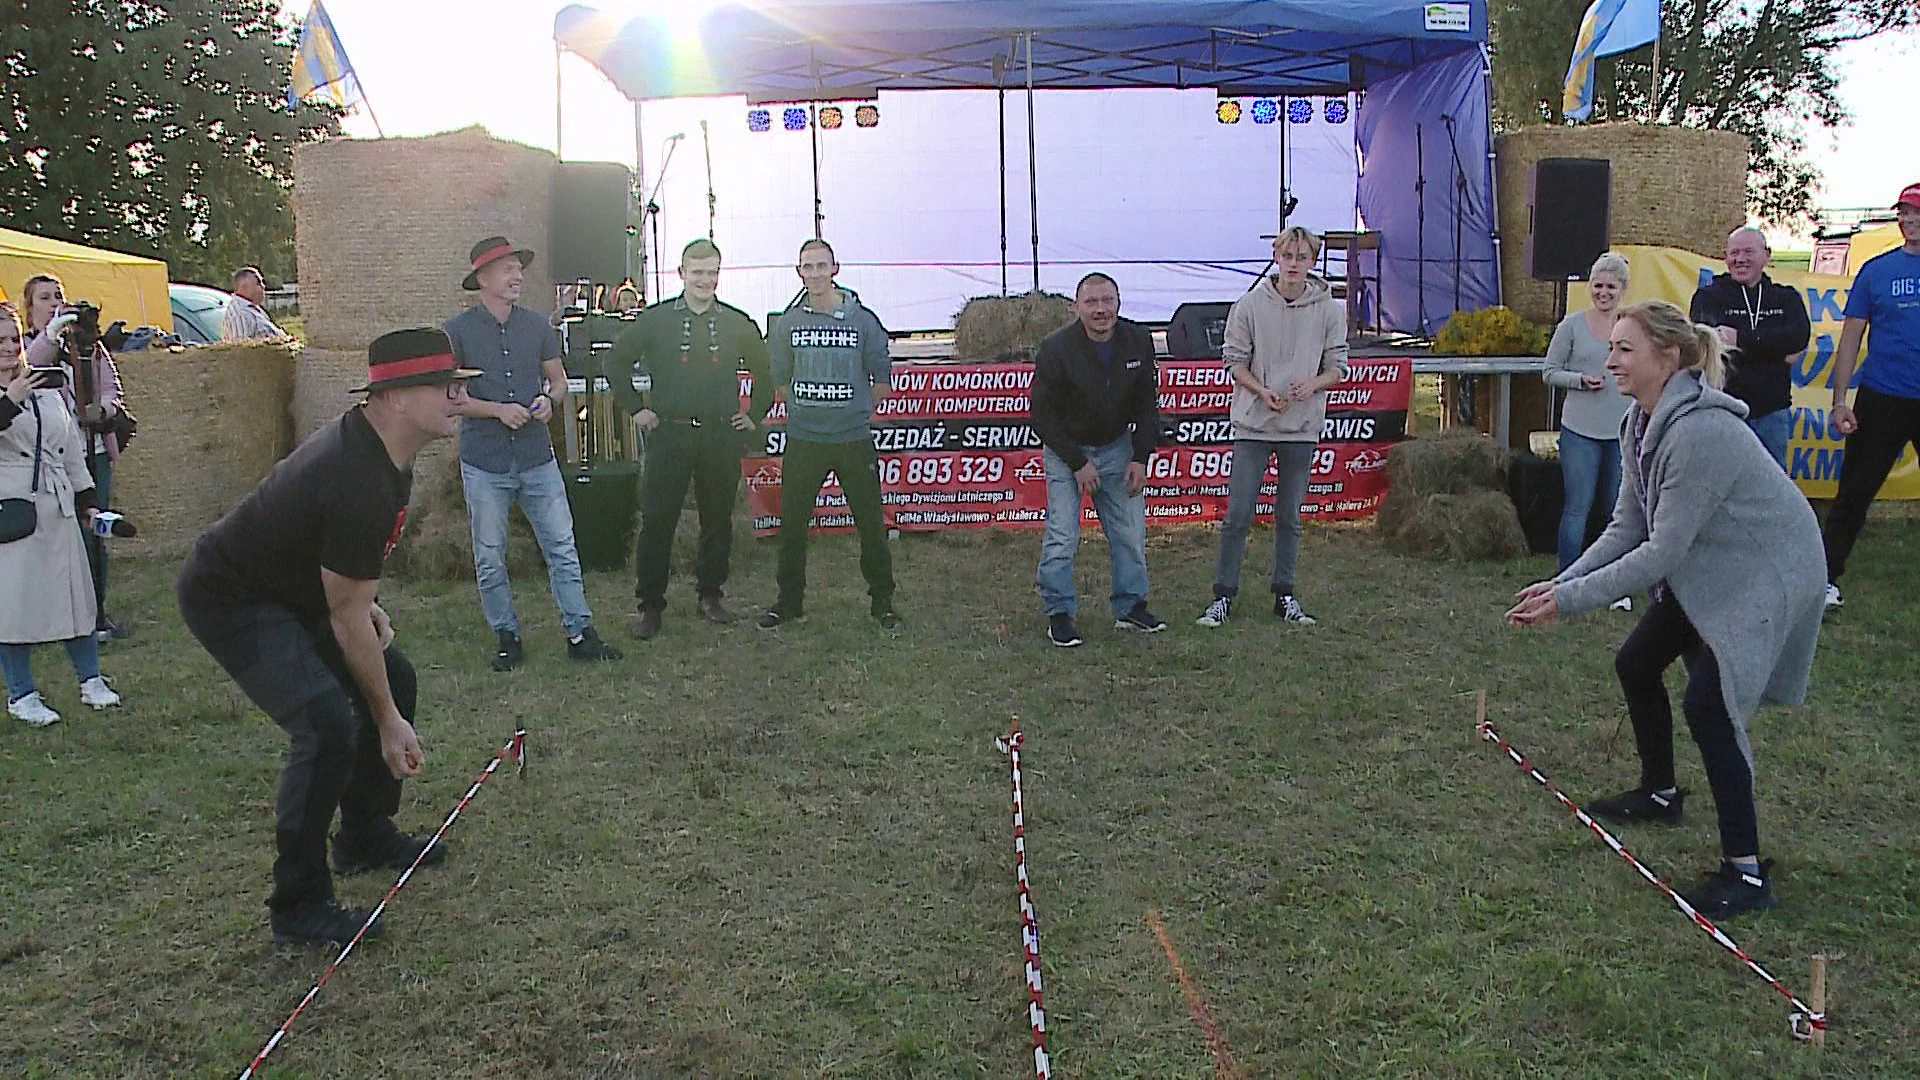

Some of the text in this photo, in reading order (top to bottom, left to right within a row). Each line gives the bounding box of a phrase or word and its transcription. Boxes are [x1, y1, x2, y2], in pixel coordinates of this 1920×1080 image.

[1892, 278, 1914, 296] BIG
[791, 330, 858, 347] GENUINE
[906, 457, 954, 484] 893
[957, 456, 1004, 483] 329
[1146, 451, 1182, 478] Tel.
[1189, 450, 1234, 478] 696
